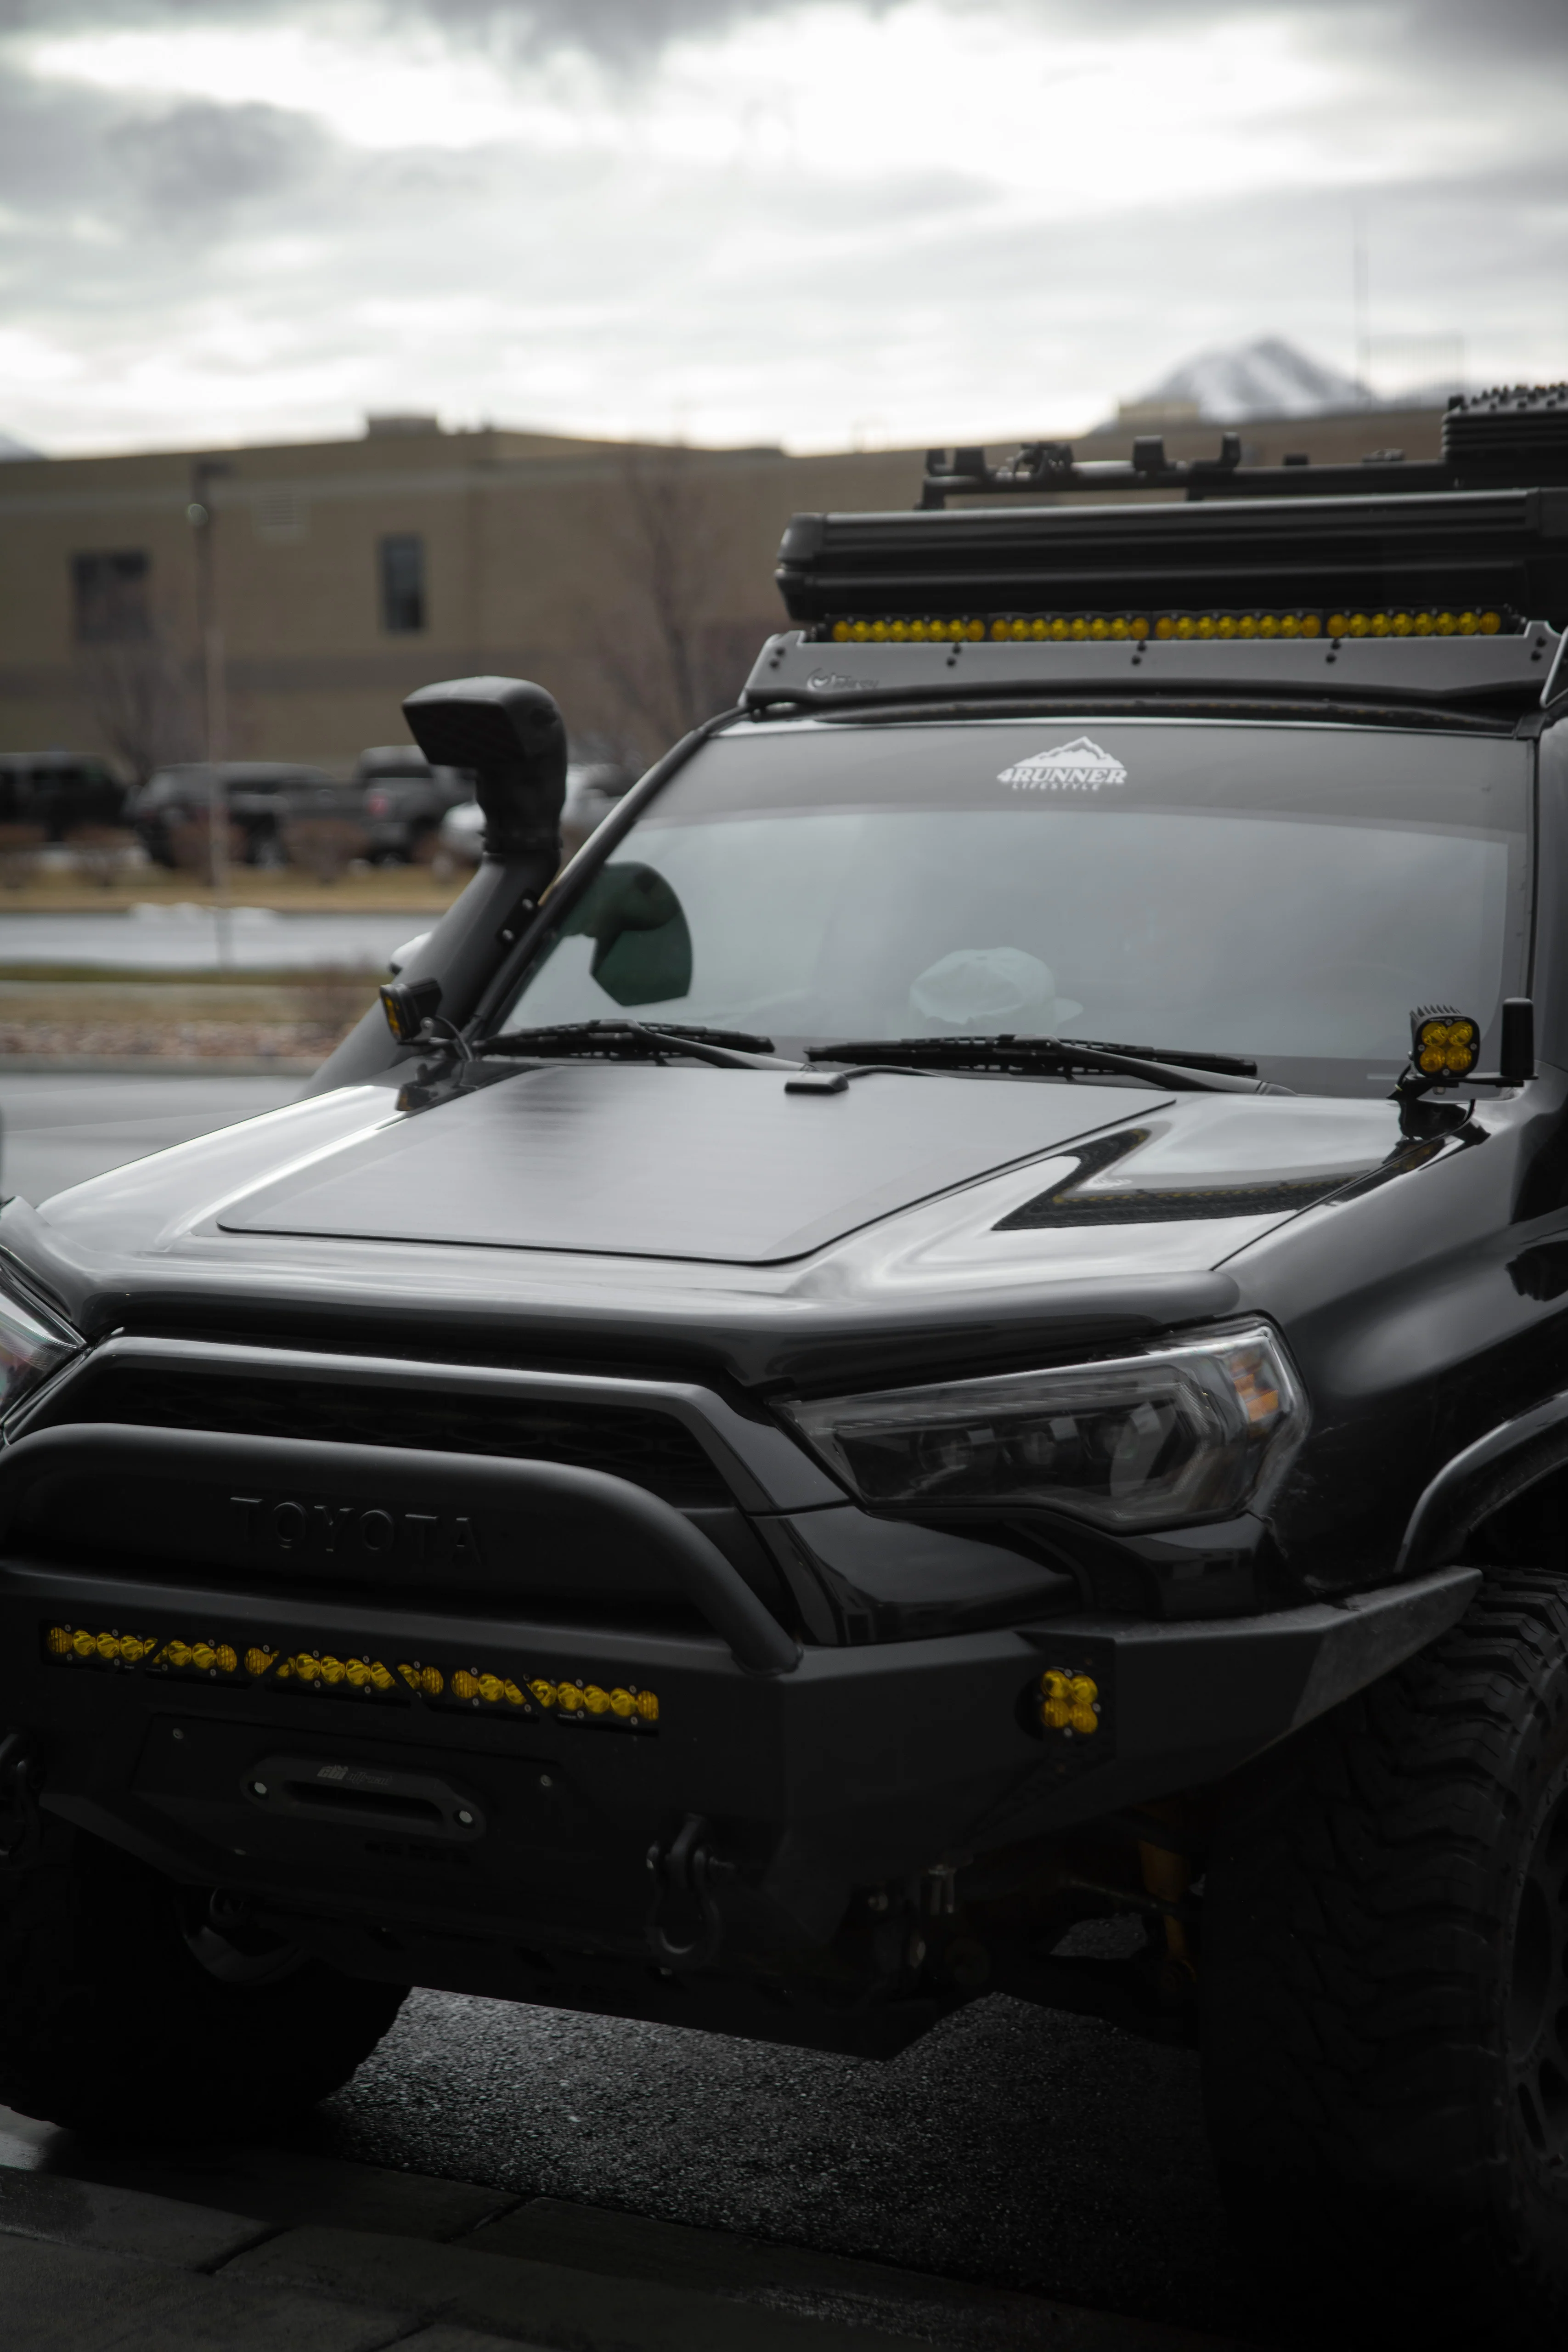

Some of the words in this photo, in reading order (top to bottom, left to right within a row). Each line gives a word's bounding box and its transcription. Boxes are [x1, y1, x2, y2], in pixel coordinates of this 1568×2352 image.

[996, 768, 1128, 783] 4RUNNER
[1012, 783, 1101, 791] LIFESTYLE
[230, 1496, 482, 1565] TOYOTA
